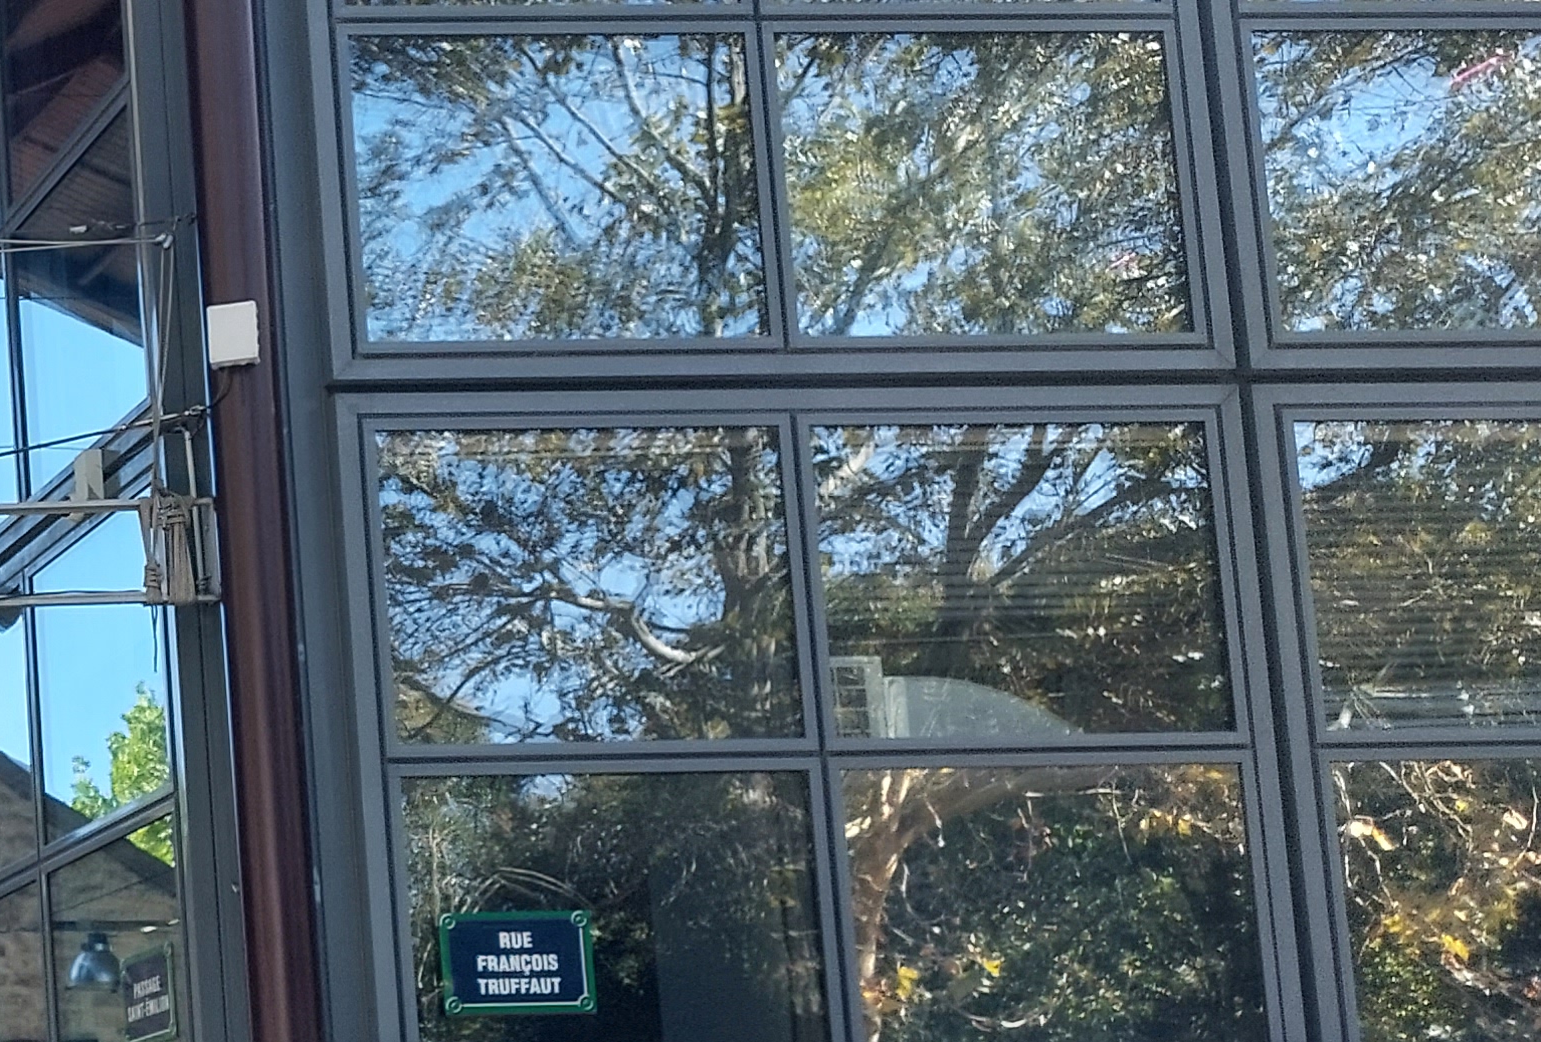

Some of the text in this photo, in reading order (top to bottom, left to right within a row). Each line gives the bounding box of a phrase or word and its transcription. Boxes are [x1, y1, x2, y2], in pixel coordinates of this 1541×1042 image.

[498, 932, 533, 950] RUE
[476, 954, 559, 977] FRANÇOIS
[477, 976, 562, 997] TRUFFAUT
